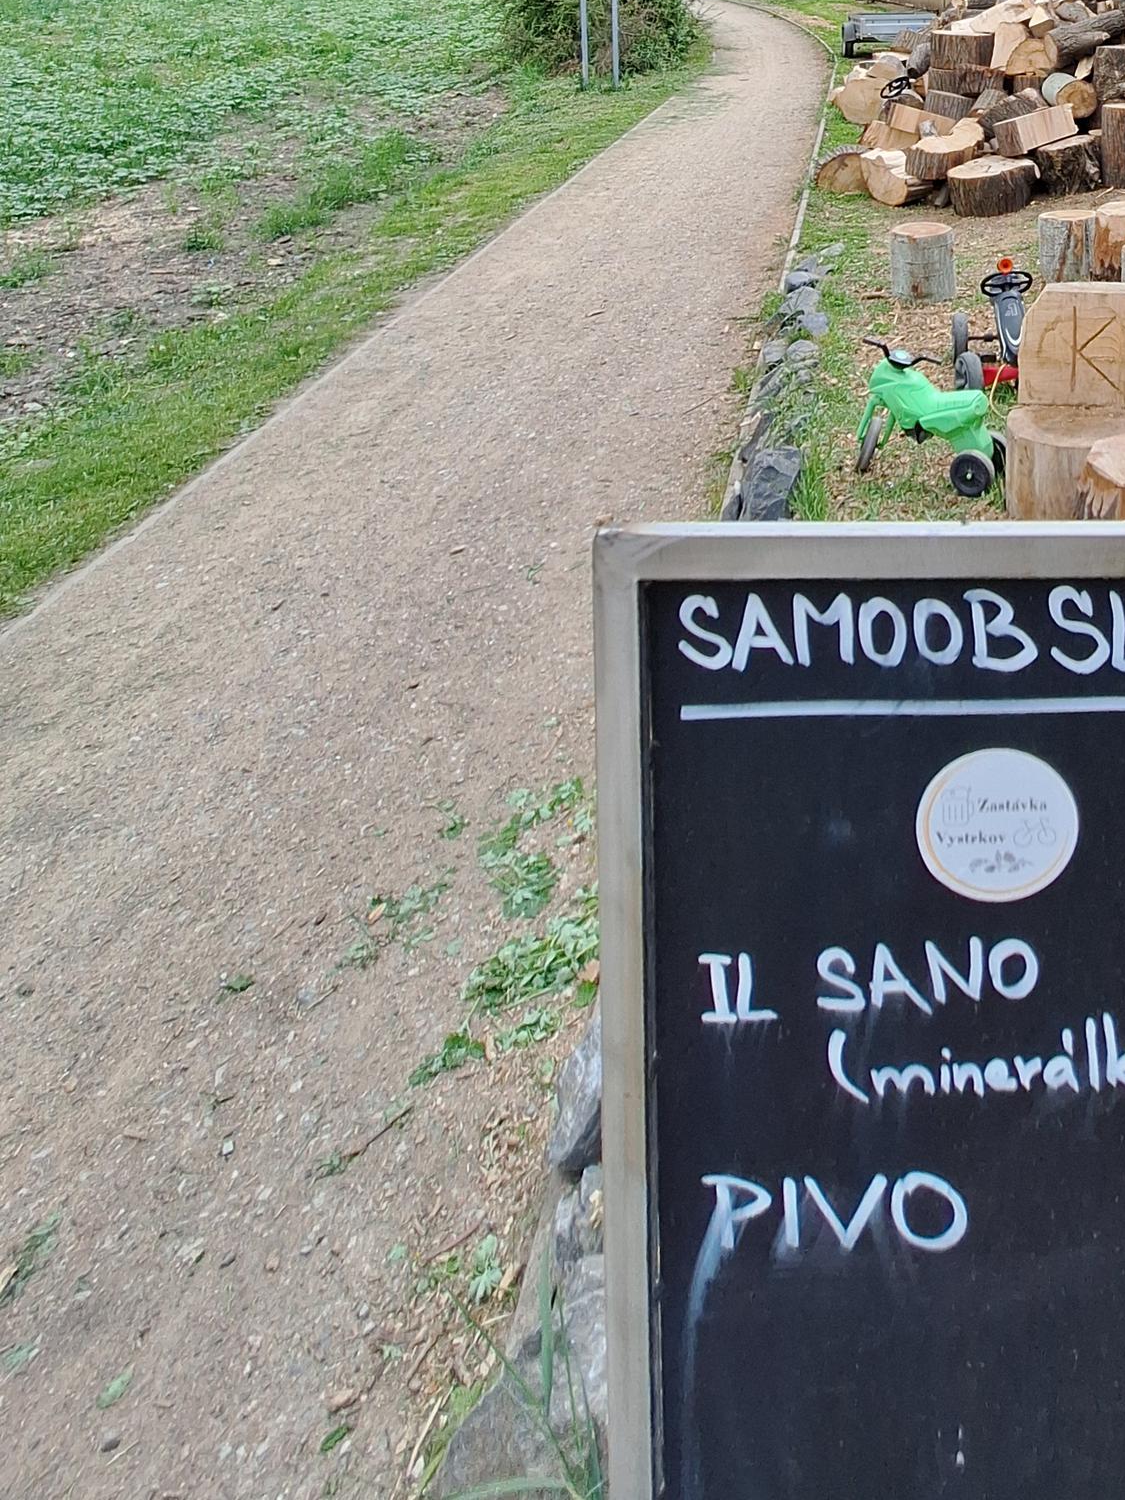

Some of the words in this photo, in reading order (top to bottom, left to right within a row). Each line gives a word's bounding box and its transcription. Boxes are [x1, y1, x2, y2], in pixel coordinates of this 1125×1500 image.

[1070, 305, 1123, 393] K
[977, 797, 1048, 813] Zastávka
[816, 936, 1039, 1015] SANO
[701, 1172, 968, 1250] PIVO
